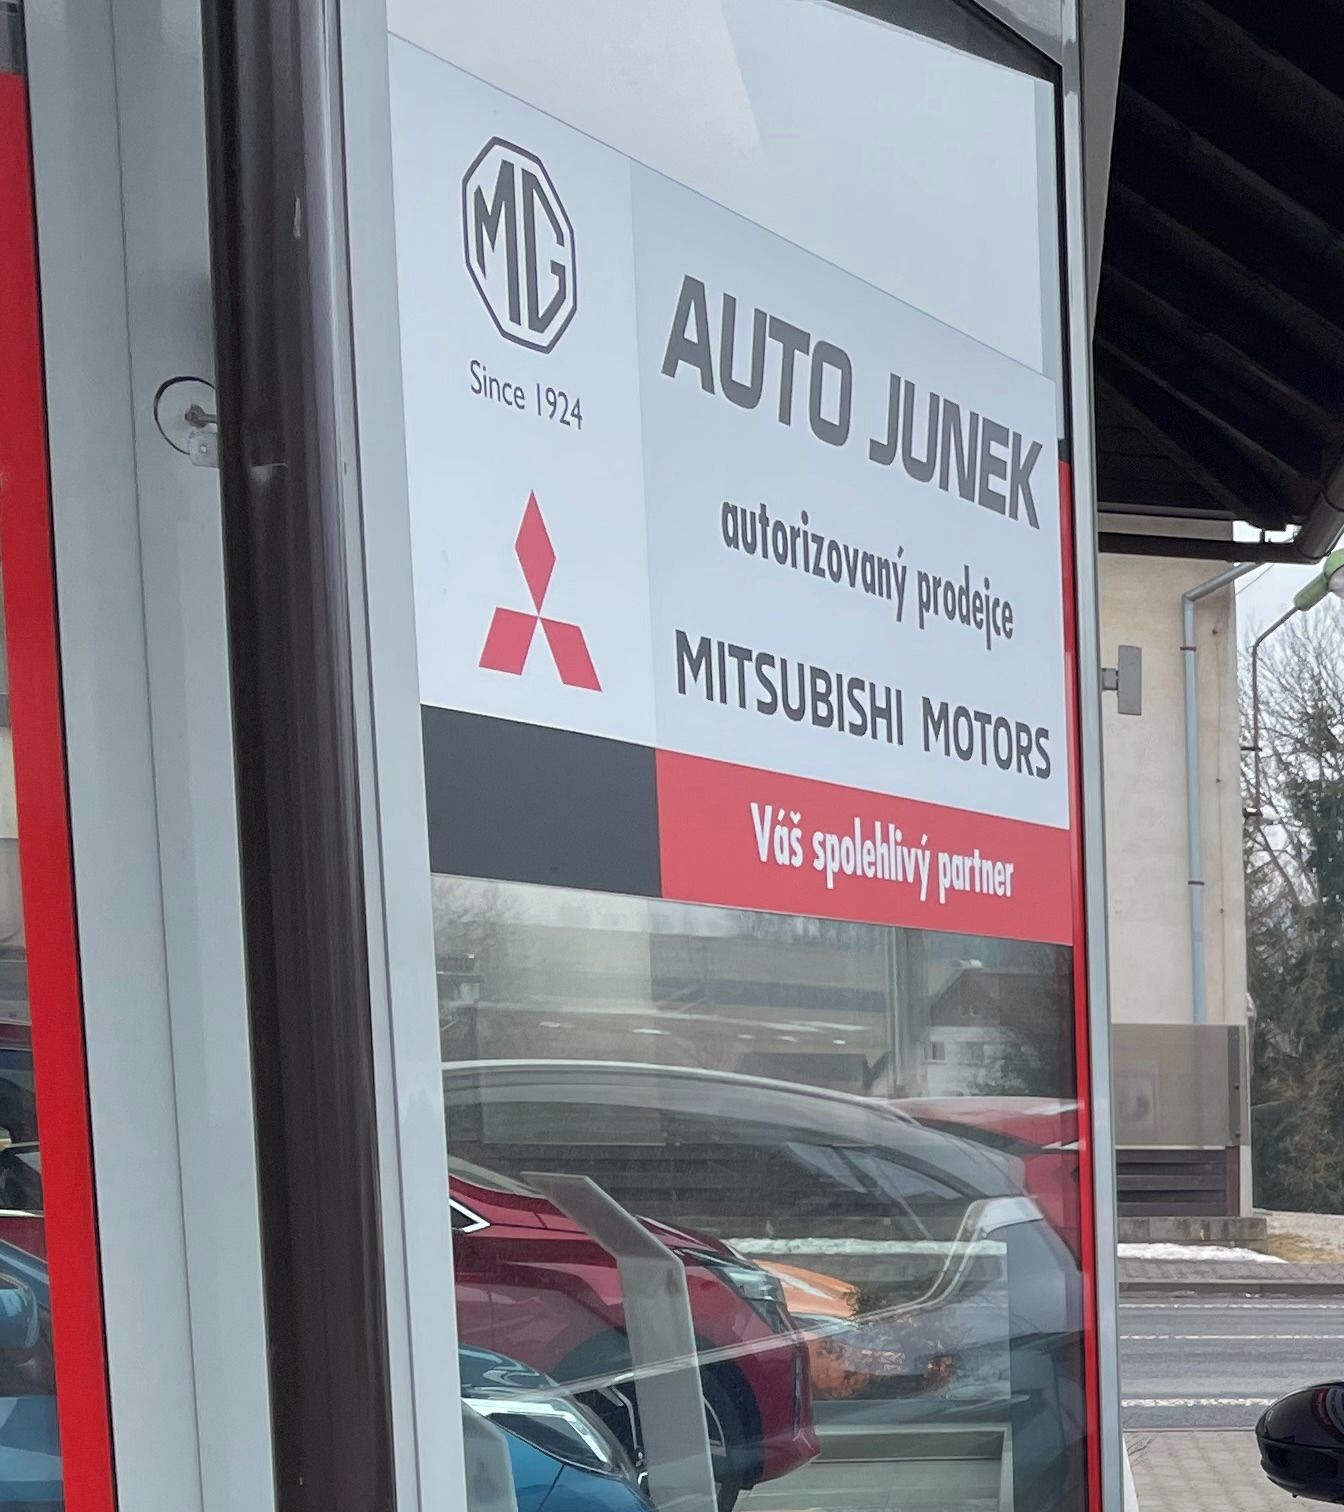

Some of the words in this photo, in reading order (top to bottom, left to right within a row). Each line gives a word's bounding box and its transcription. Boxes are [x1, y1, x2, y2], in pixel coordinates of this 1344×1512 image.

[473, 158, 568, 335] MG
[468, 359, 526, 415] Since
[534, 381, 584, 431] 1924
[661, 274, 852, 447] AUTO
[868, 371, 1043, 530] JUNEK
[720, 498, 908, 622] autorizovaný
[917, 564, 1014, 651] prodejce
[674, 629, 905, 747] MITSUBISHI
[920, 694, 1052, 780] MOTORS
[750, 801, 804, 870] Váš
[811, 820, 932, 903] spolehlivý
[937, 849, 1015, 904] partner
